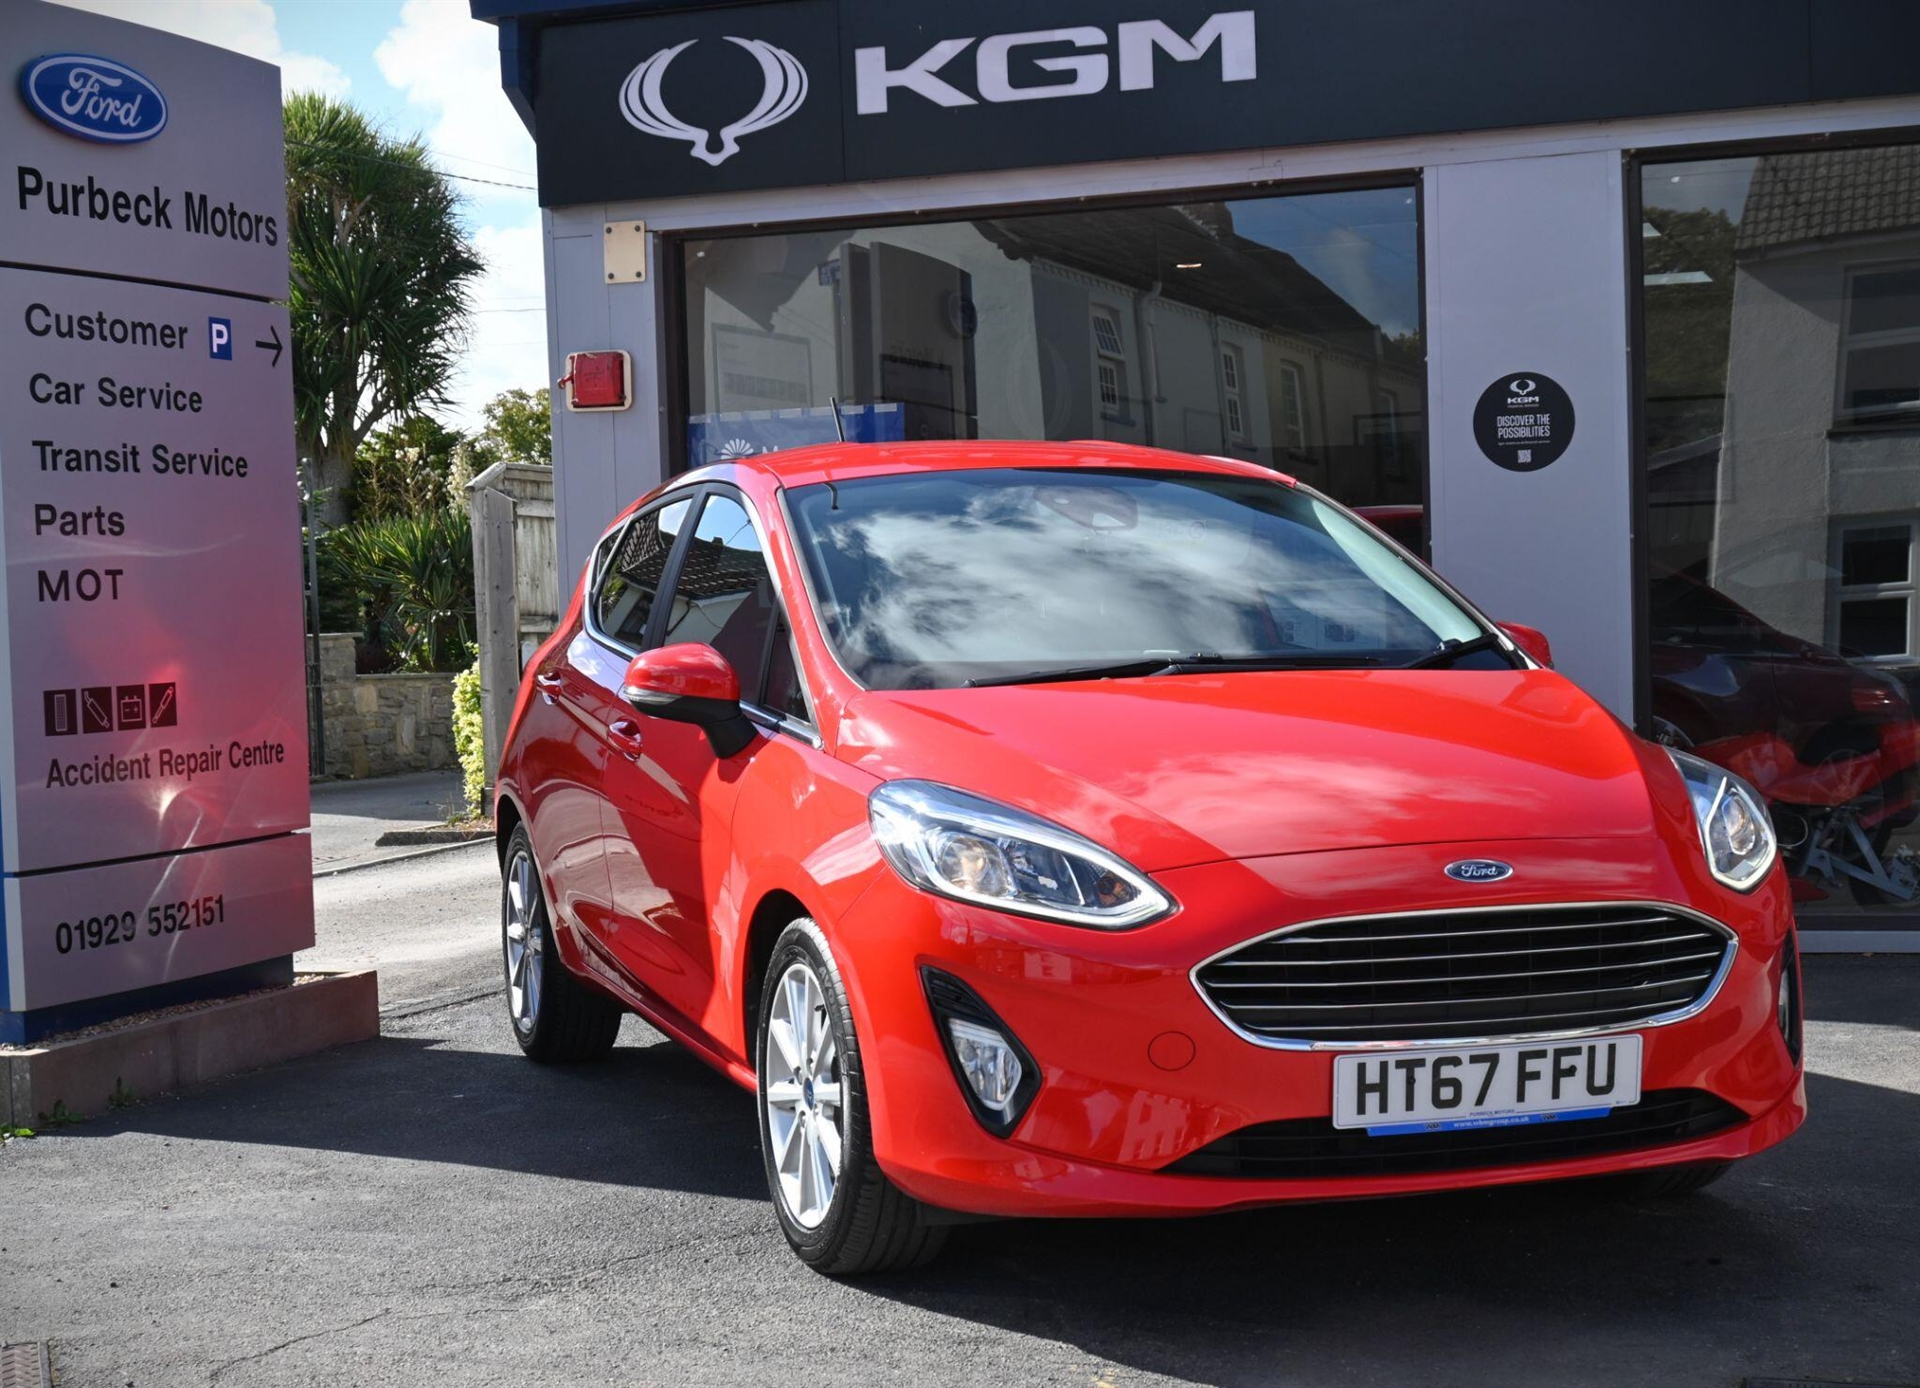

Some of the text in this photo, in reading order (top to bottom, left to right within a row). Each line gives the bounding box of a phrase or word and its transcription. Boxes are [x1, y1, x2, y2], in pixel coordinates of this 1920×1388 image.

[854, 10, 1257, 115] KGM
[61, 67, 143, 127] Ford
[17, 165, 278, 247] Purbeck Motors
[24, 303, 229, 353] Customer P
[29, 373, 203, 413] Car Service
[1507, 396, 1540, 404] KGM
[1496, 413, 1551, 427] DISCOVER THE
[1497, 425, 1551, 439] POSSIBILITIES
[32, 440, 248, 478] Transit Service
[34, 503, 126, 537] Parts
[37, 568, 124, 602] MOT
[46, 739, 285, 789] Accident Repair Centre
[1461, 864, 1498, 877] Ford
[55, 894, 226, 955] 01929 552151
[1356, 1042, 1617, 1116] HT67 FFU
